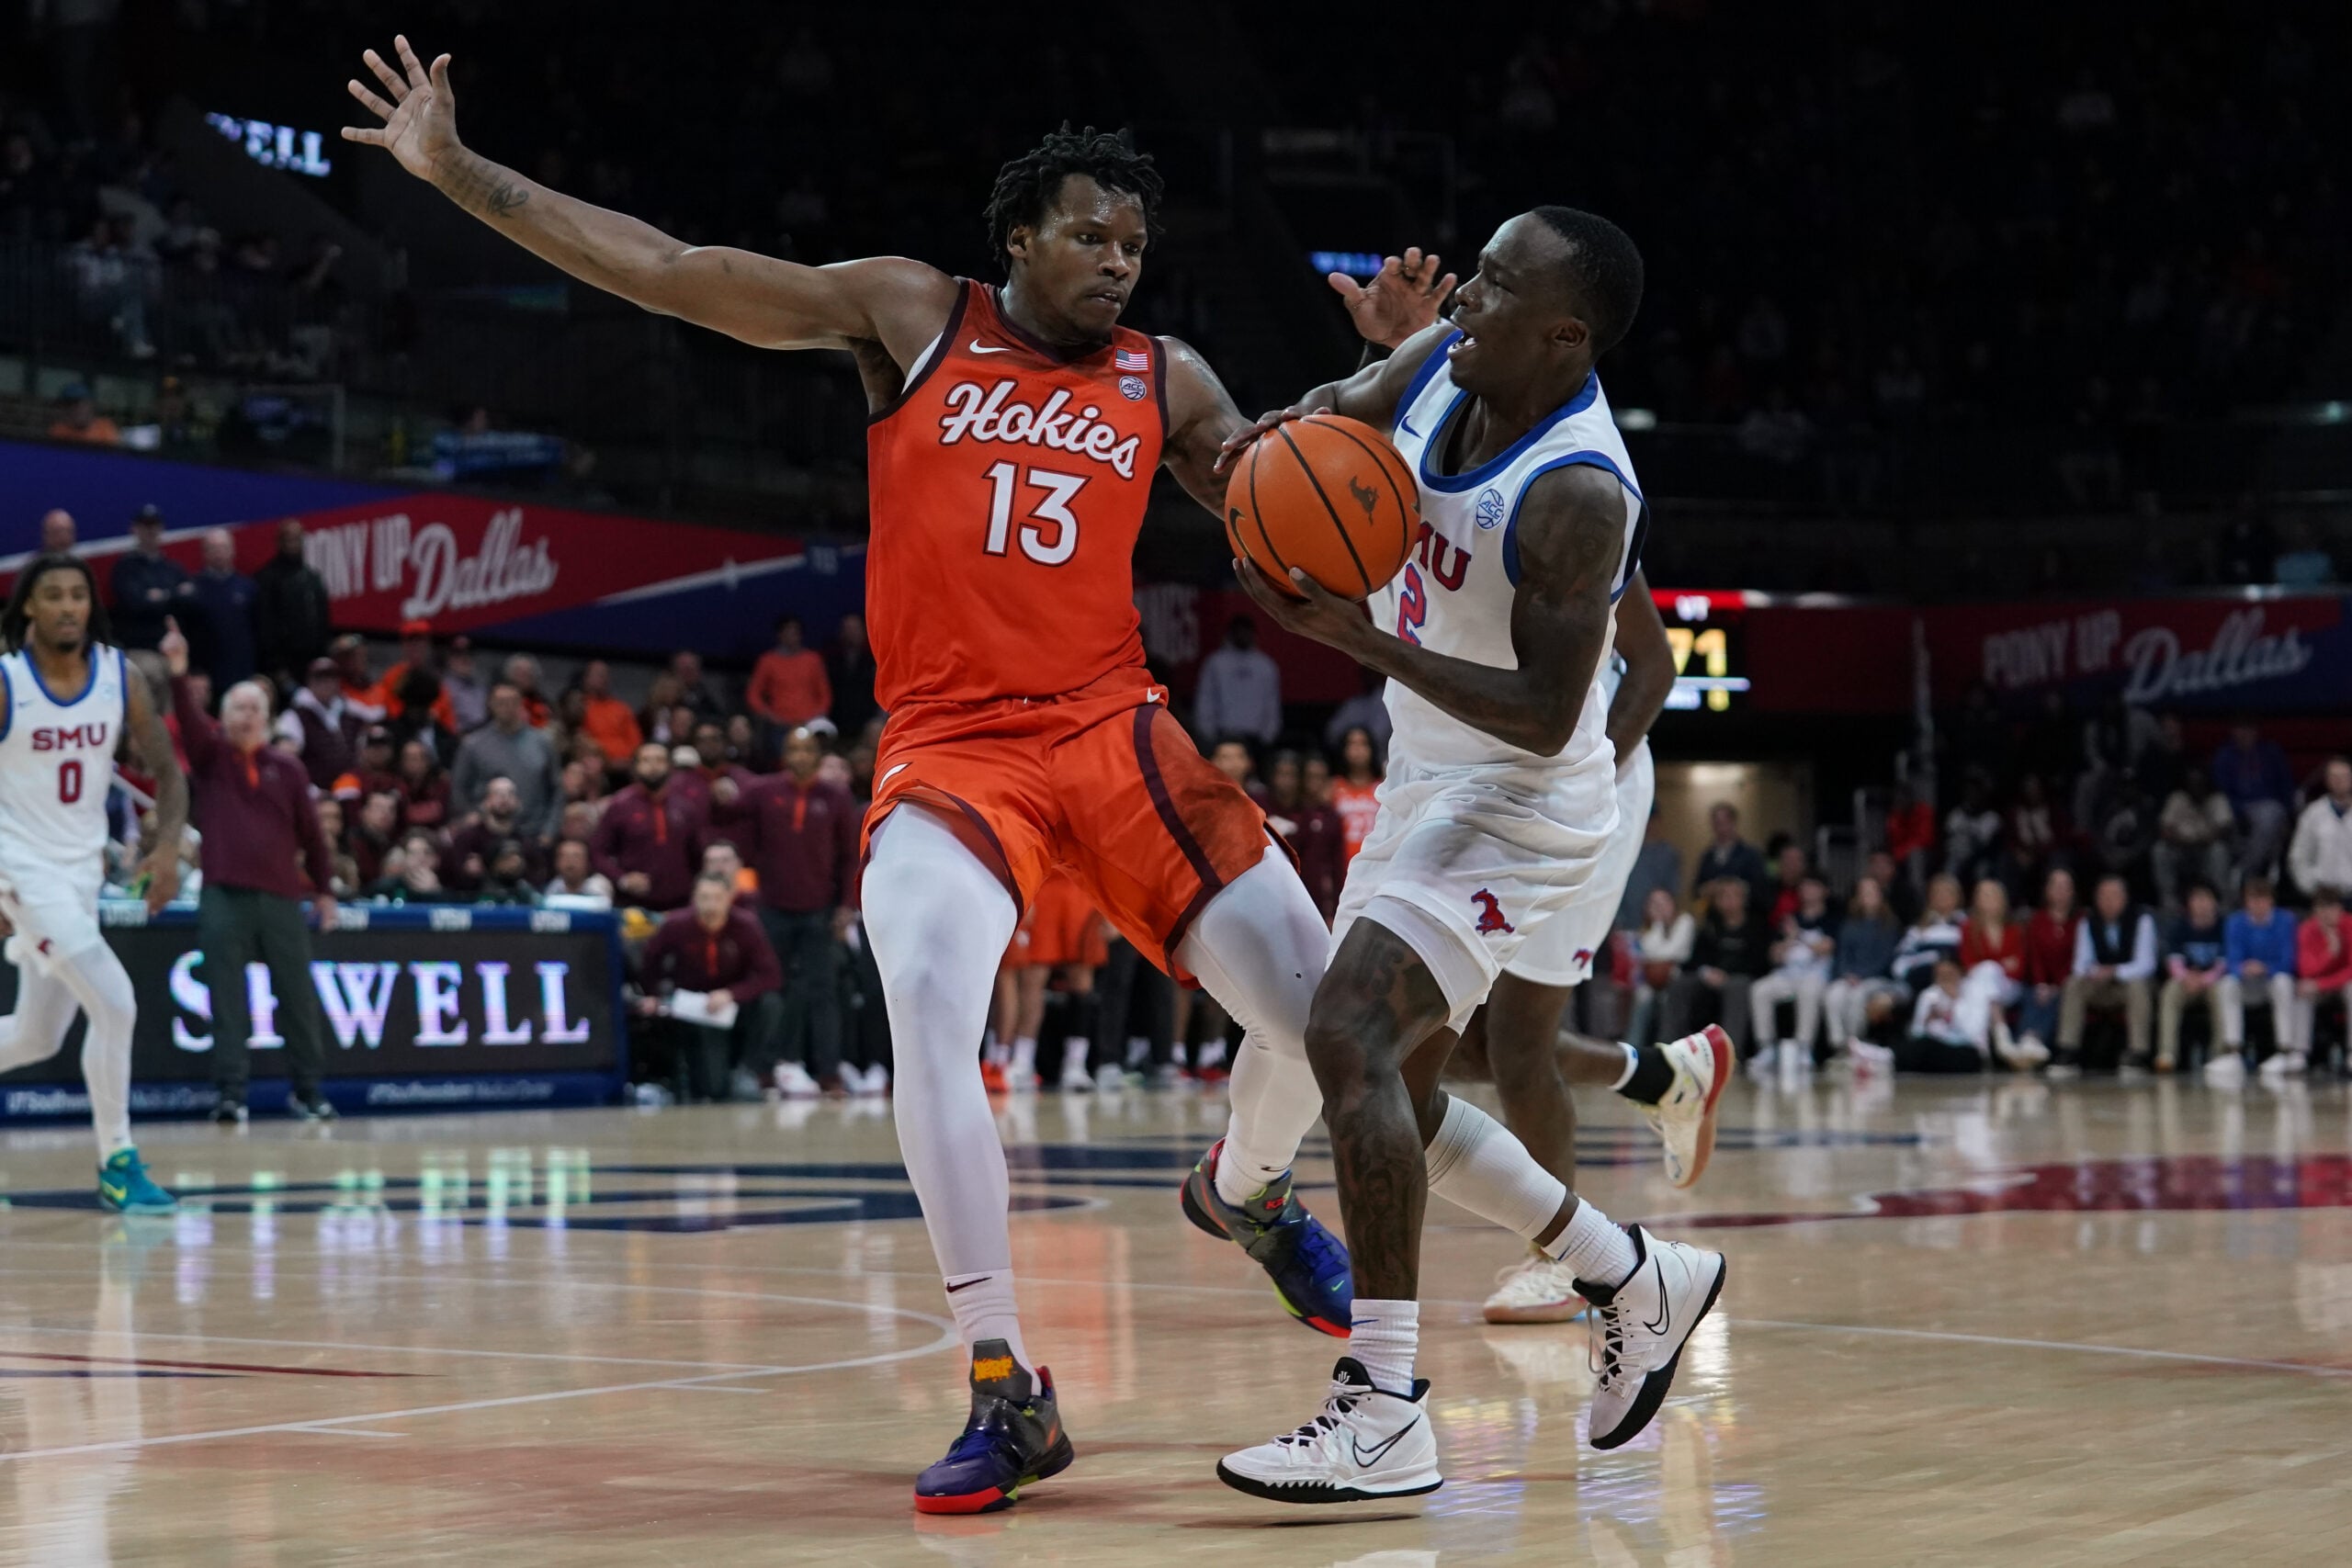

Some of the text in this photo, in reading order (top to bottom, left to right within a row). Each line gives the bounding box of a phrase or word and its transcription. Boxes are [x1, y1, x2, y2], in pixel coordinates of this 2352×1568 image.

[939, 378, 1140, 480] Hokies
[981, 459, 1092, 568] 13
[401, 507, 559, 618] Dallas
[1397, 562, 1427, 646] 2
[1665, 627, 1727, 677] 71
[1983, 606, 2312, 704] PONY UP Dallas
[32, 722, 107, 751] SMU
[59, 759, 83, 805] 0
